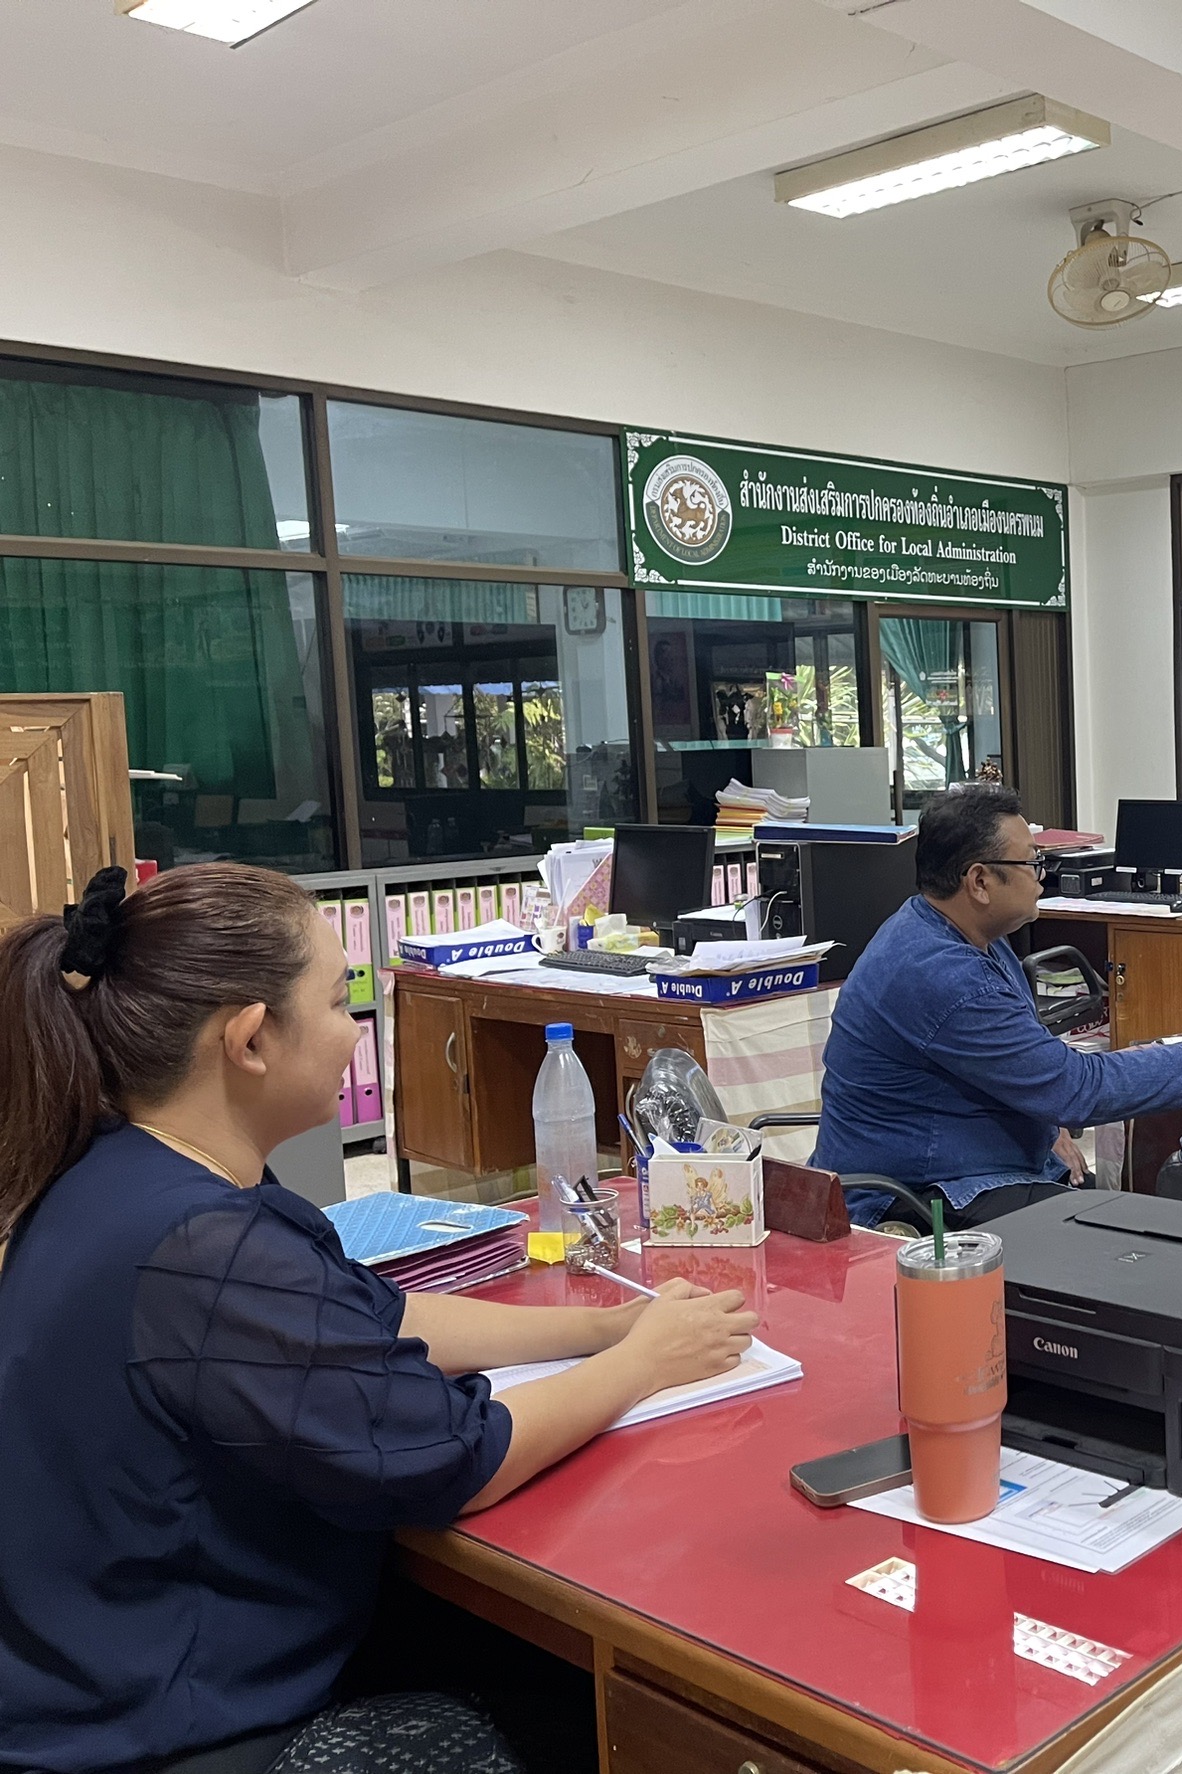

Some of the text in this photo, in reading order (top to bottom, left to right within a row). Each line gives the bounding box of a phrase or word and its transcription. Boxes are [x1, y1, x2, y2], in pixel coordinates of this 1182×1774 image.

[780, 525, 1017, 564] District Office for Local Administration
[451, 941, 525, 961] Double A
[661, 981, 668, 994] A
[731, 971, 804, 995] Double A
[1033, 1337, 1078, 1359] Canon
